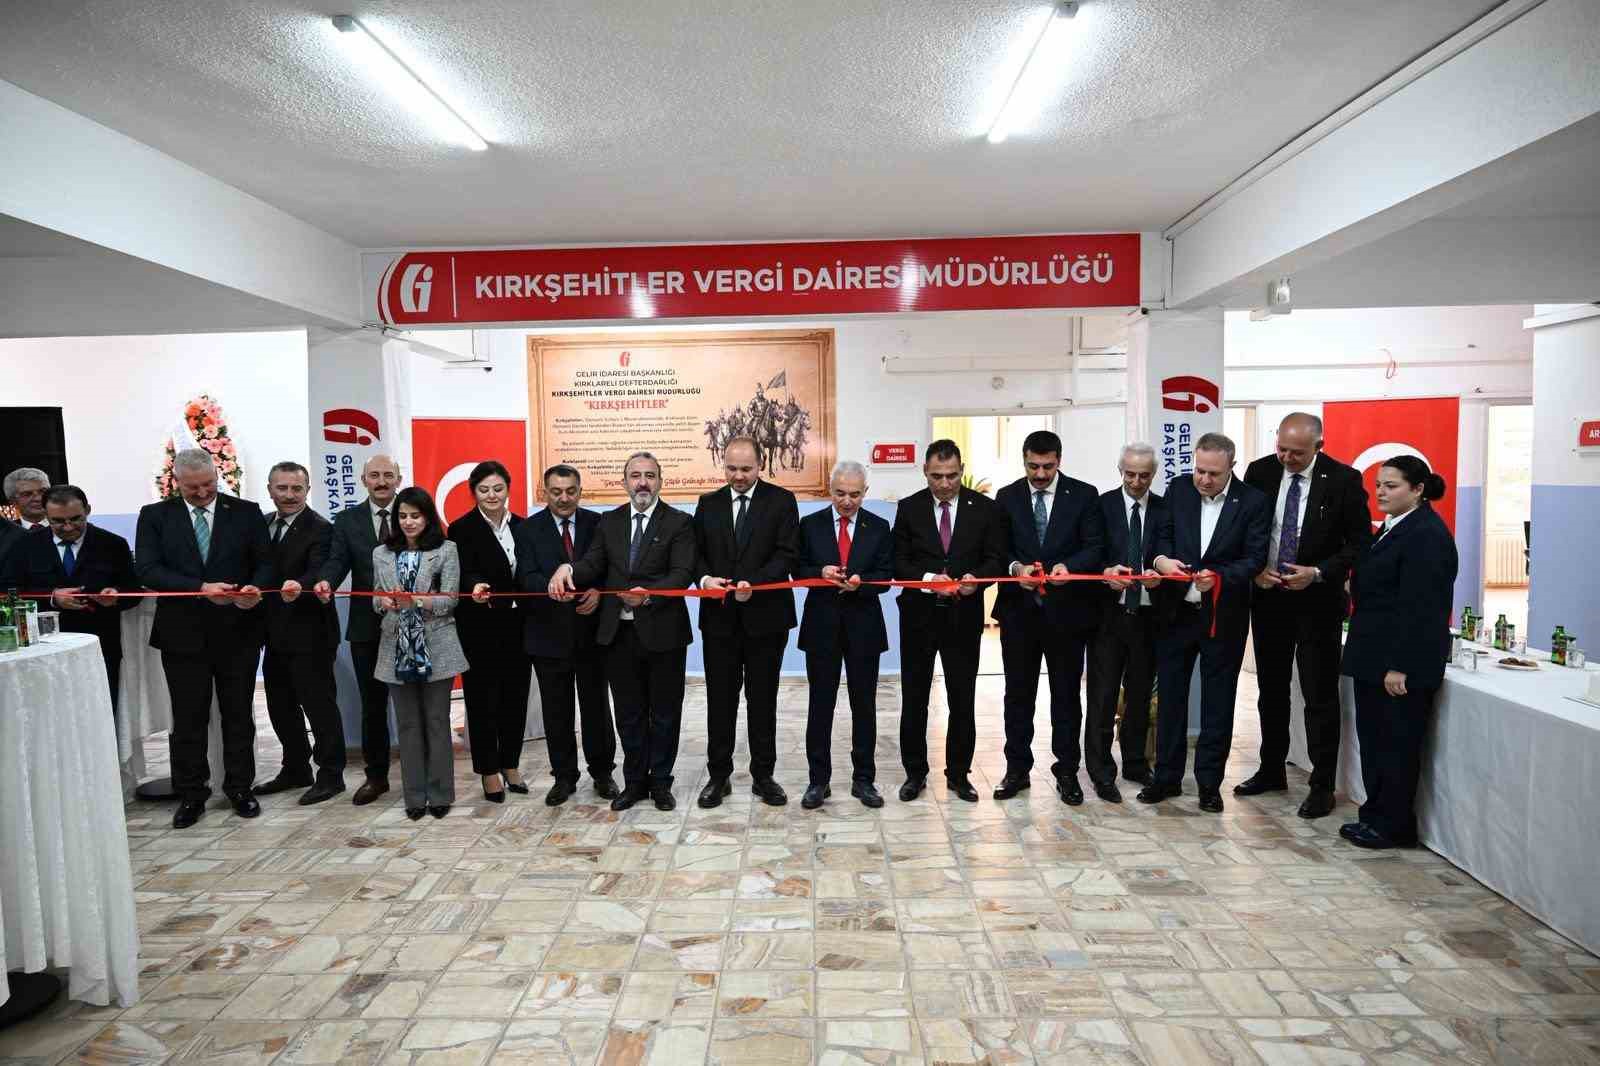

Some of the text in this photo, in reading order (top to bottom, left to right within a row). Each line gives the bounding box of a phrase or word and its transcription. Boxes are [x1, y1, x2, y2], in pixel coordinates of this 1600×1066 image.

[475, 266, 685, 302] KIRKŞEHİTLER
[693, 261, 783, 293] VERGİ
[918, 252, 1114, 288] MÜDÜRLÜĞÜ
[1161, 423, 1177, 480] BAŞKA
[1178, 422, 1193, 465] GELİR
[341, 454, 357, 496] GELİR
